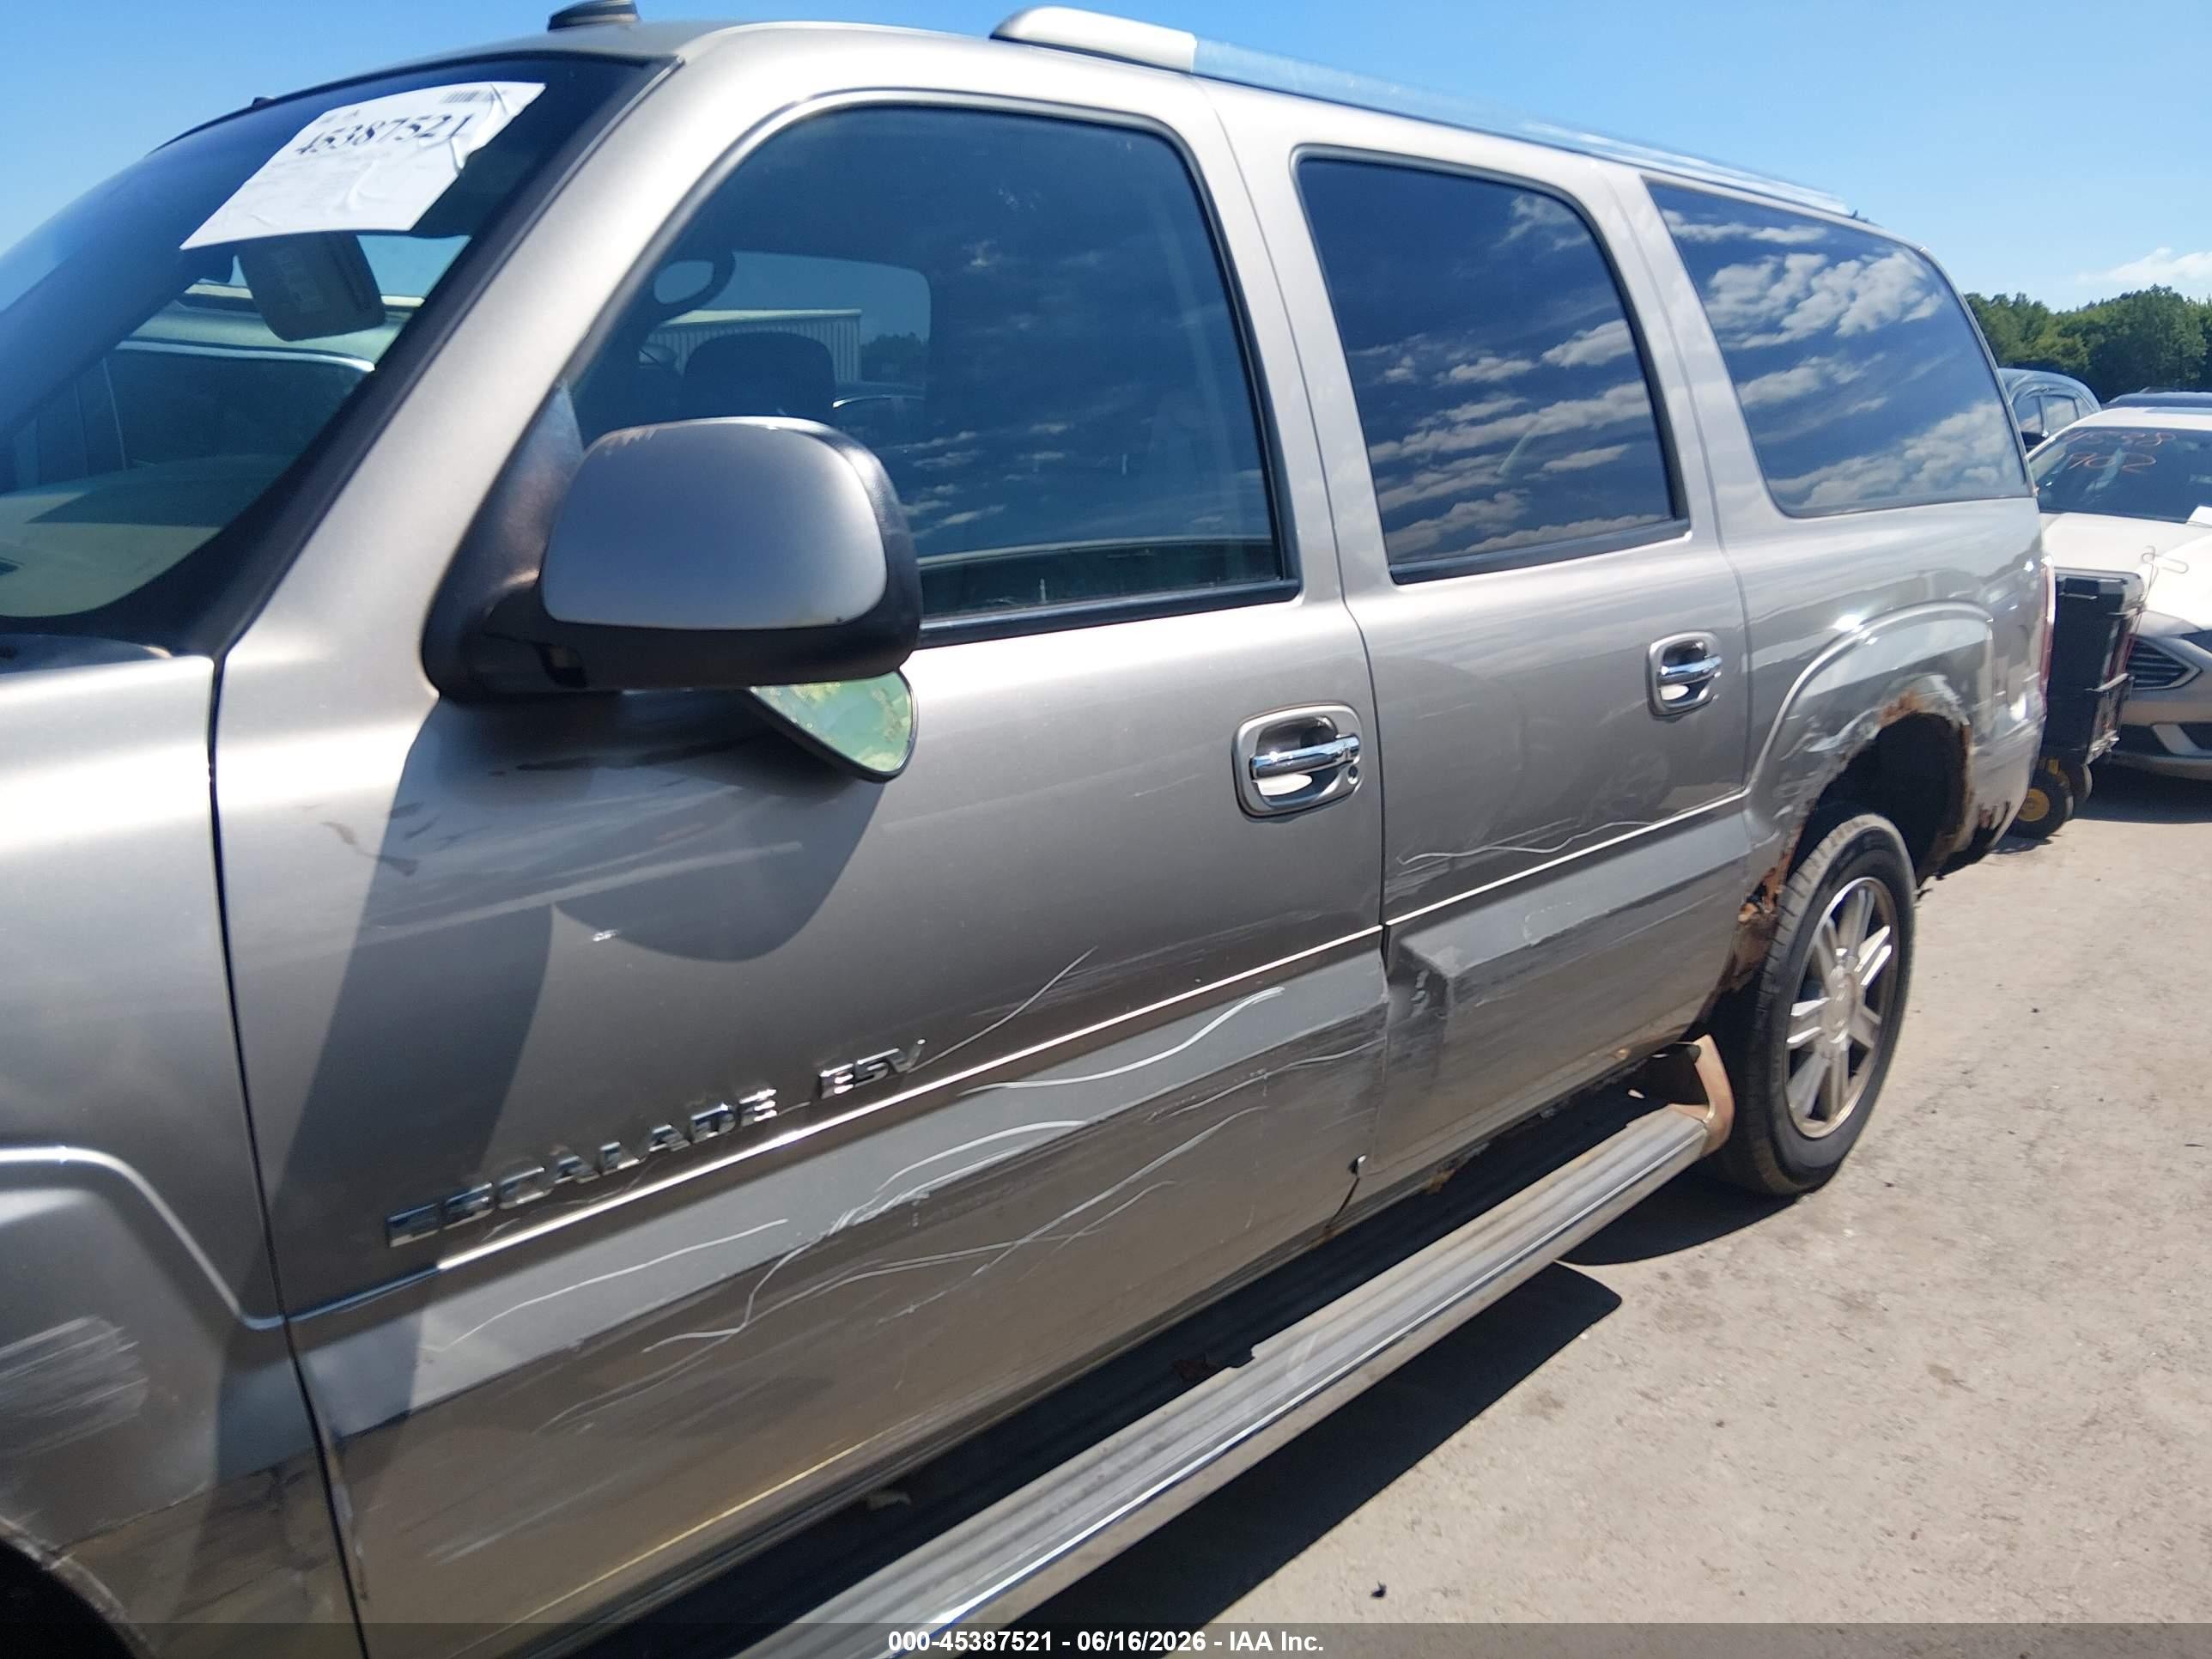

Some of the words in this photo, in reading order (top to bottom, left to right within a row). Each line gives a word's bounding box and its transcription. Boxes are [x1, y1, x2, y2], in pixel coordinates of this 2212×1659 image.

[295, 112, 474, 155] 45387521
[386, 1087, 777, 1248] ESCALADE
[818, 1038, 927, 1100] ESV
